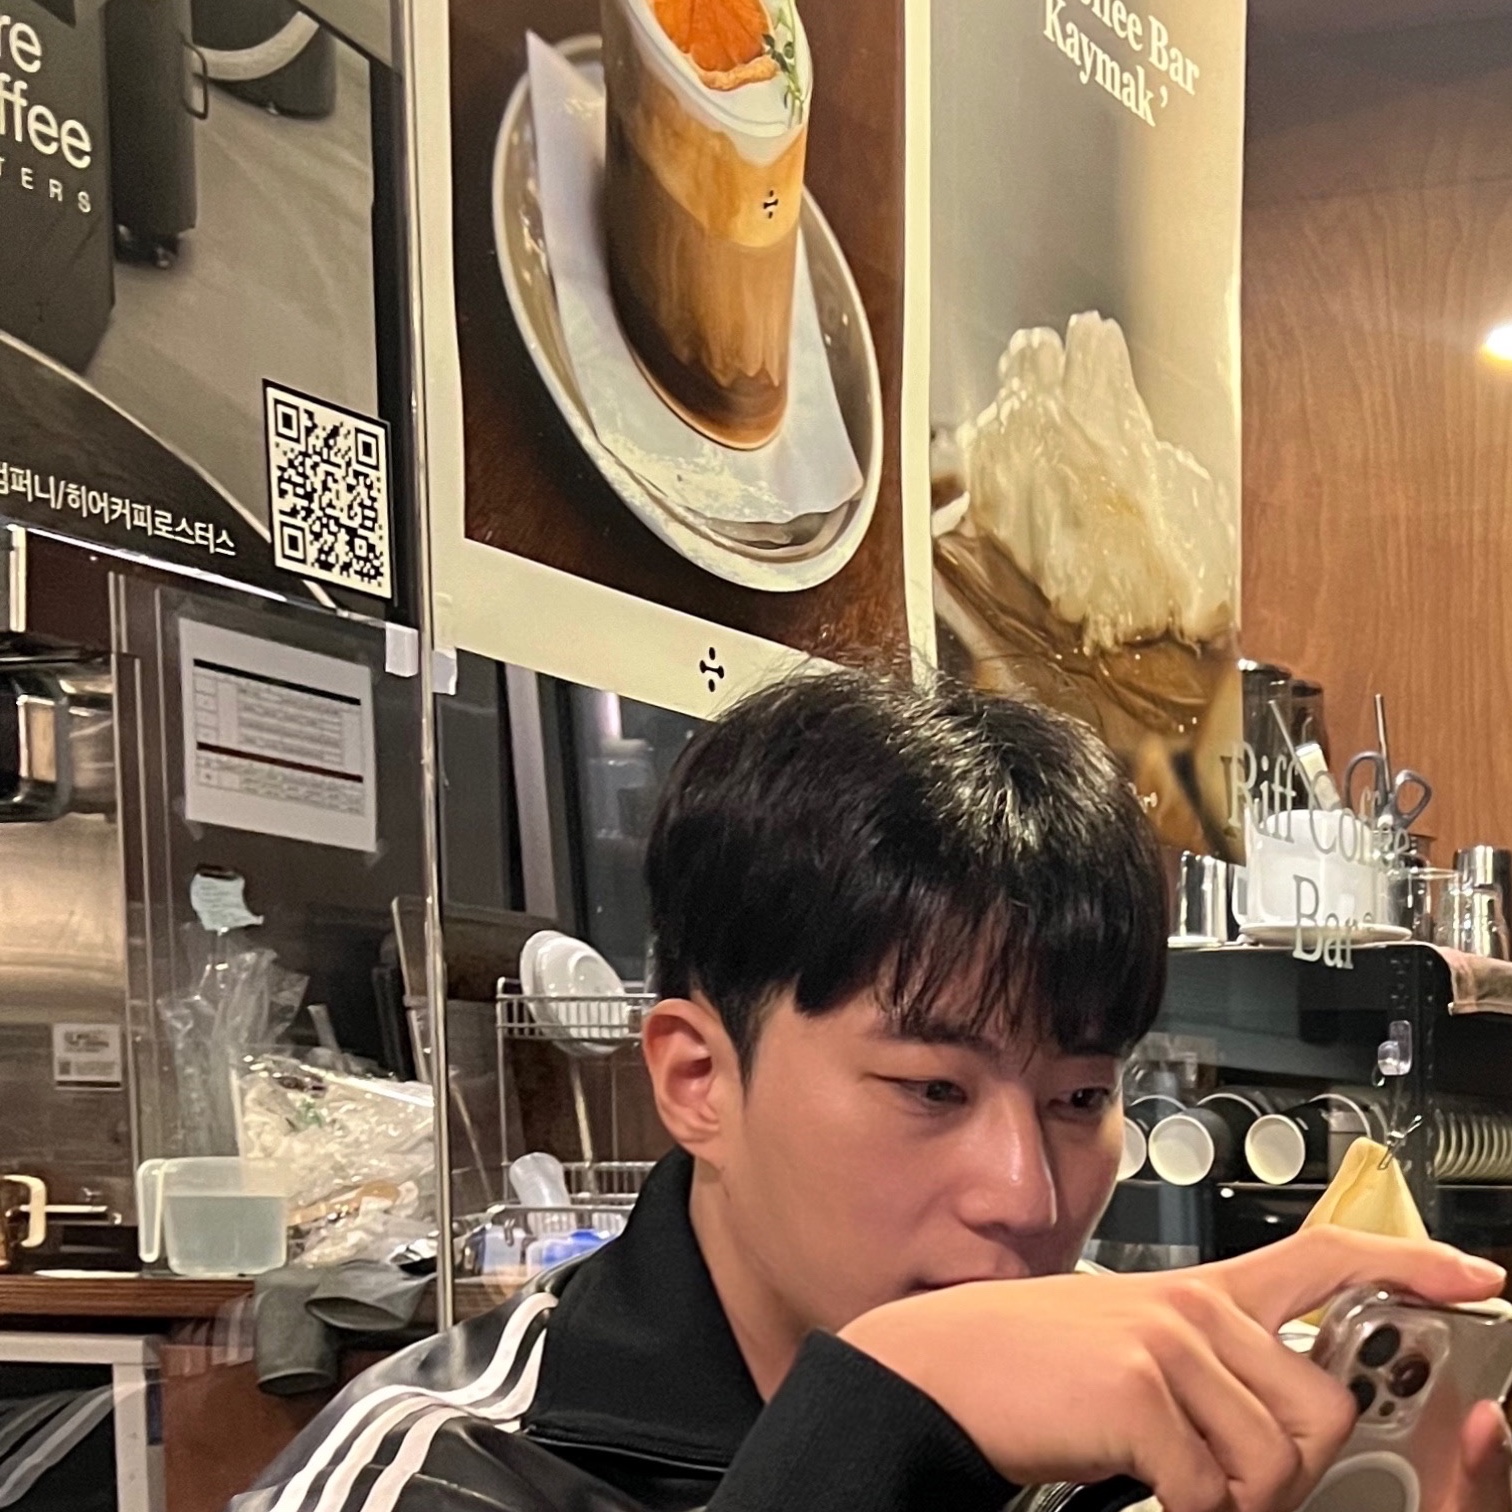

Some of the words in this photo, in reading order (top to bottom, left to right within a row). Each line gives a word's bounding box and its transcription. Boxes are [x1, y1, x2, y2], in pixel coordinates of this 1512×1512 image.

[1149, 15, 1199, 96] Bar
[1228, 741, 1300, 843] Riff
[1292, 874, 1358, 970] Bar
